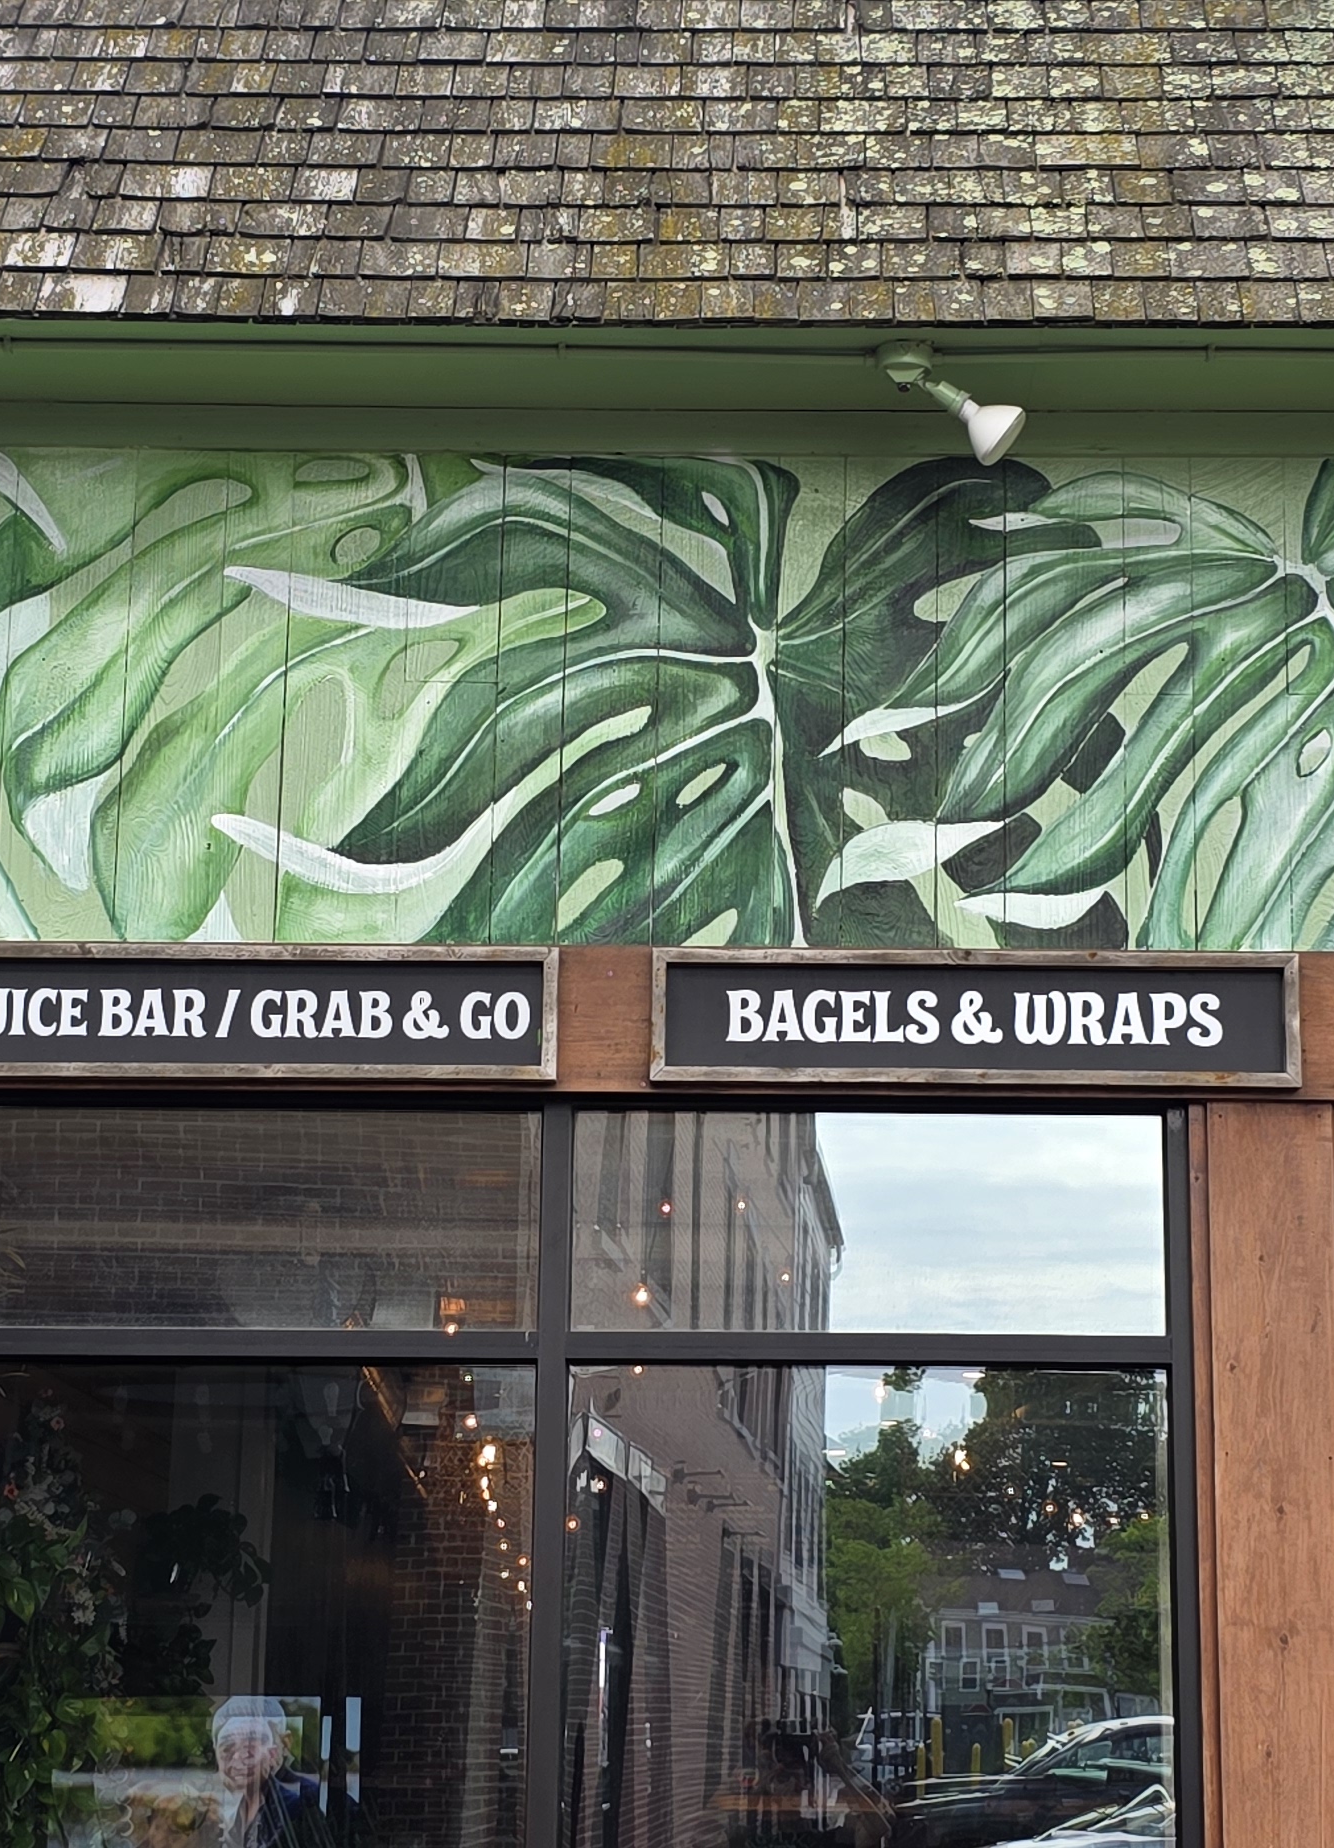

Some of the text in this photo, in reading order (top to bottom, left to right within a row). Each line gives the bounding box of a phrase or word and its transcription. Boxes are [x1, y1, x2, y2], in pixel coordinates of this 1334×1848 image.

[98, 988, 207, 1038] BAR
[215, 989, 241, 1038] /
[251, 989, 393, 1039] GRAB
[403, 990, 450, 1040] &
[459, 991, 531, 1040] GO
[725, 989, 1224, 1047] BAGELS & WRAPS
